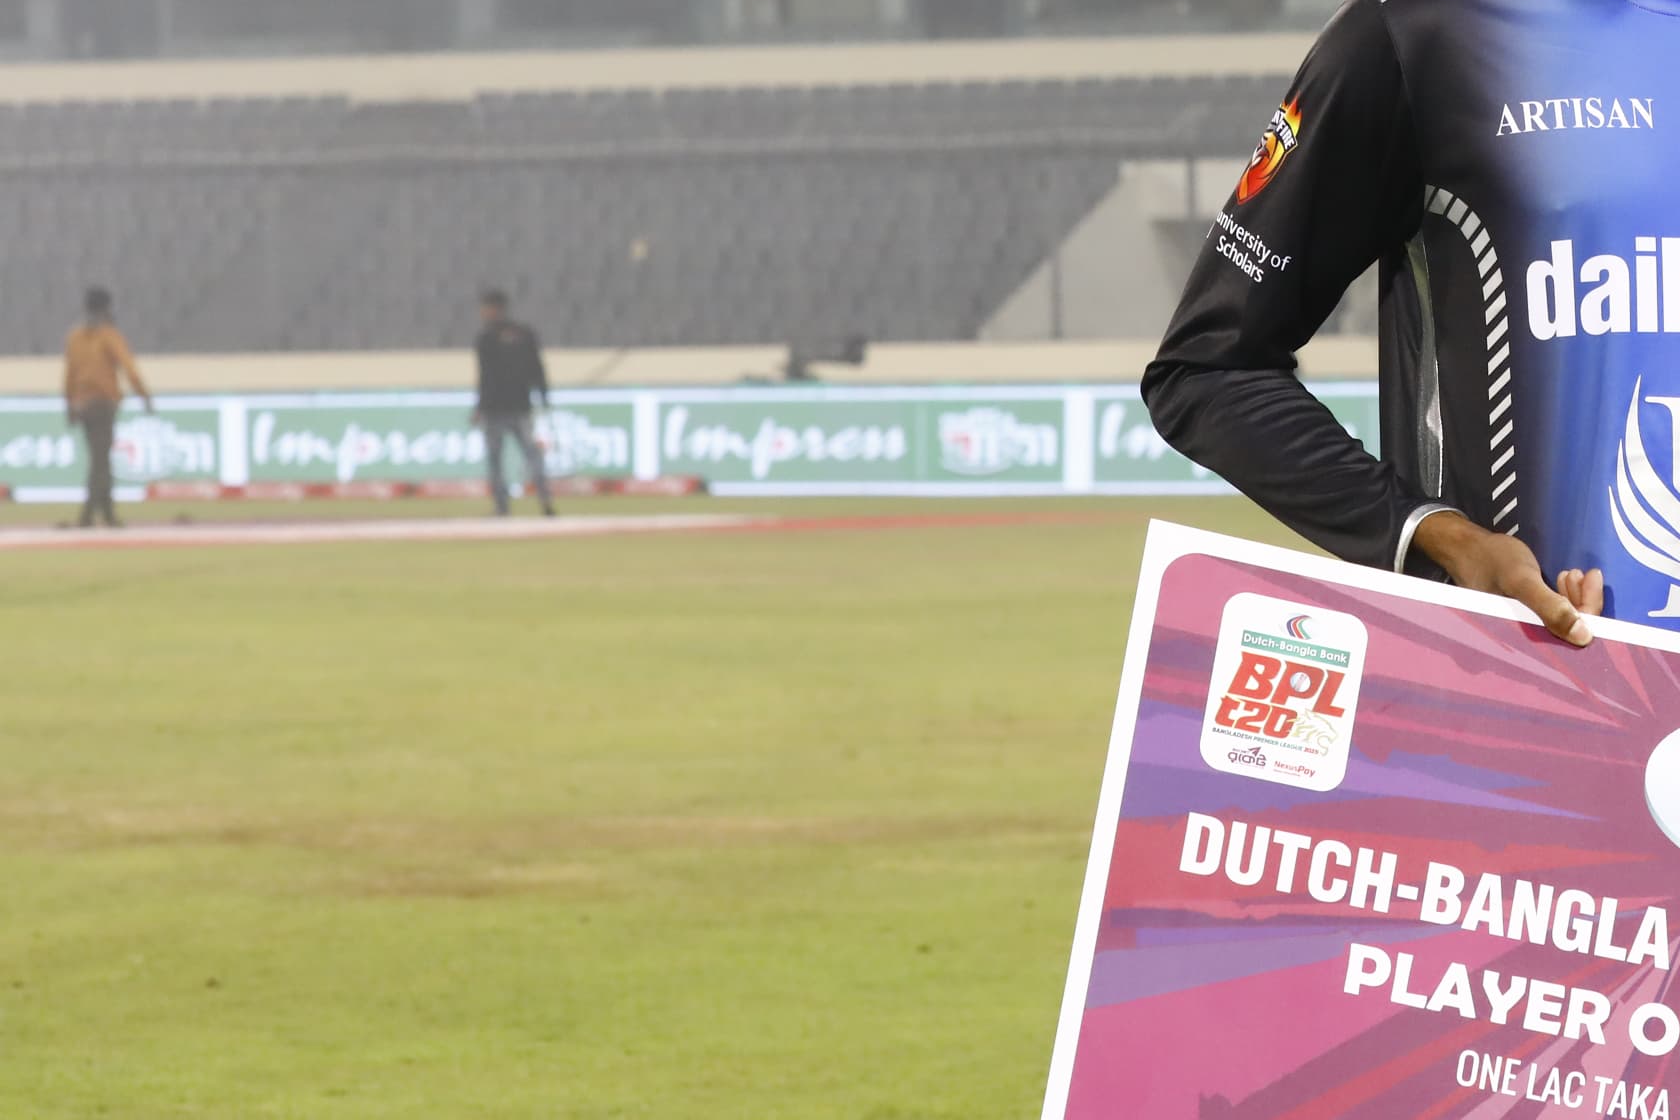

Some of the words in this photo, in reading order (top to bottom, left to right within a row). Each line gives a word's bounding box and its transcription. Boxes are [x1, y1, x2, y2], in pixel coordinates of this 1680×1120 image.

[1495, 97, 1655, 137] ARTISAN
[1215, 235, 1264, 283] Scholars
[1270, 254, 1292, 272] of
[663, 403, 909, 478] Impress
[1243, 632, 1318, 657] Dutch-Bangla
[1319, 650, 1348, 664] Bank
[1227, 651, 1346, 719] BPL
[1212, 727, 1253, 741] BANGLADESH
[1252, 735, 1280, 746] PREMIER
[1279, 741, 1303, 751] LEAGUE
[1273, 760, 1316, 778] NexusPay
[1178, 811, 1671, 971] DUTCH-BANGLA
[1342, 942, 1612, 1046] PLAYER
[1455, 1049, 1522, 1098] ONE
[1525, 1064, 1586, 1111] LAC
[1593, 1075, 1670, 1120] TAKA
